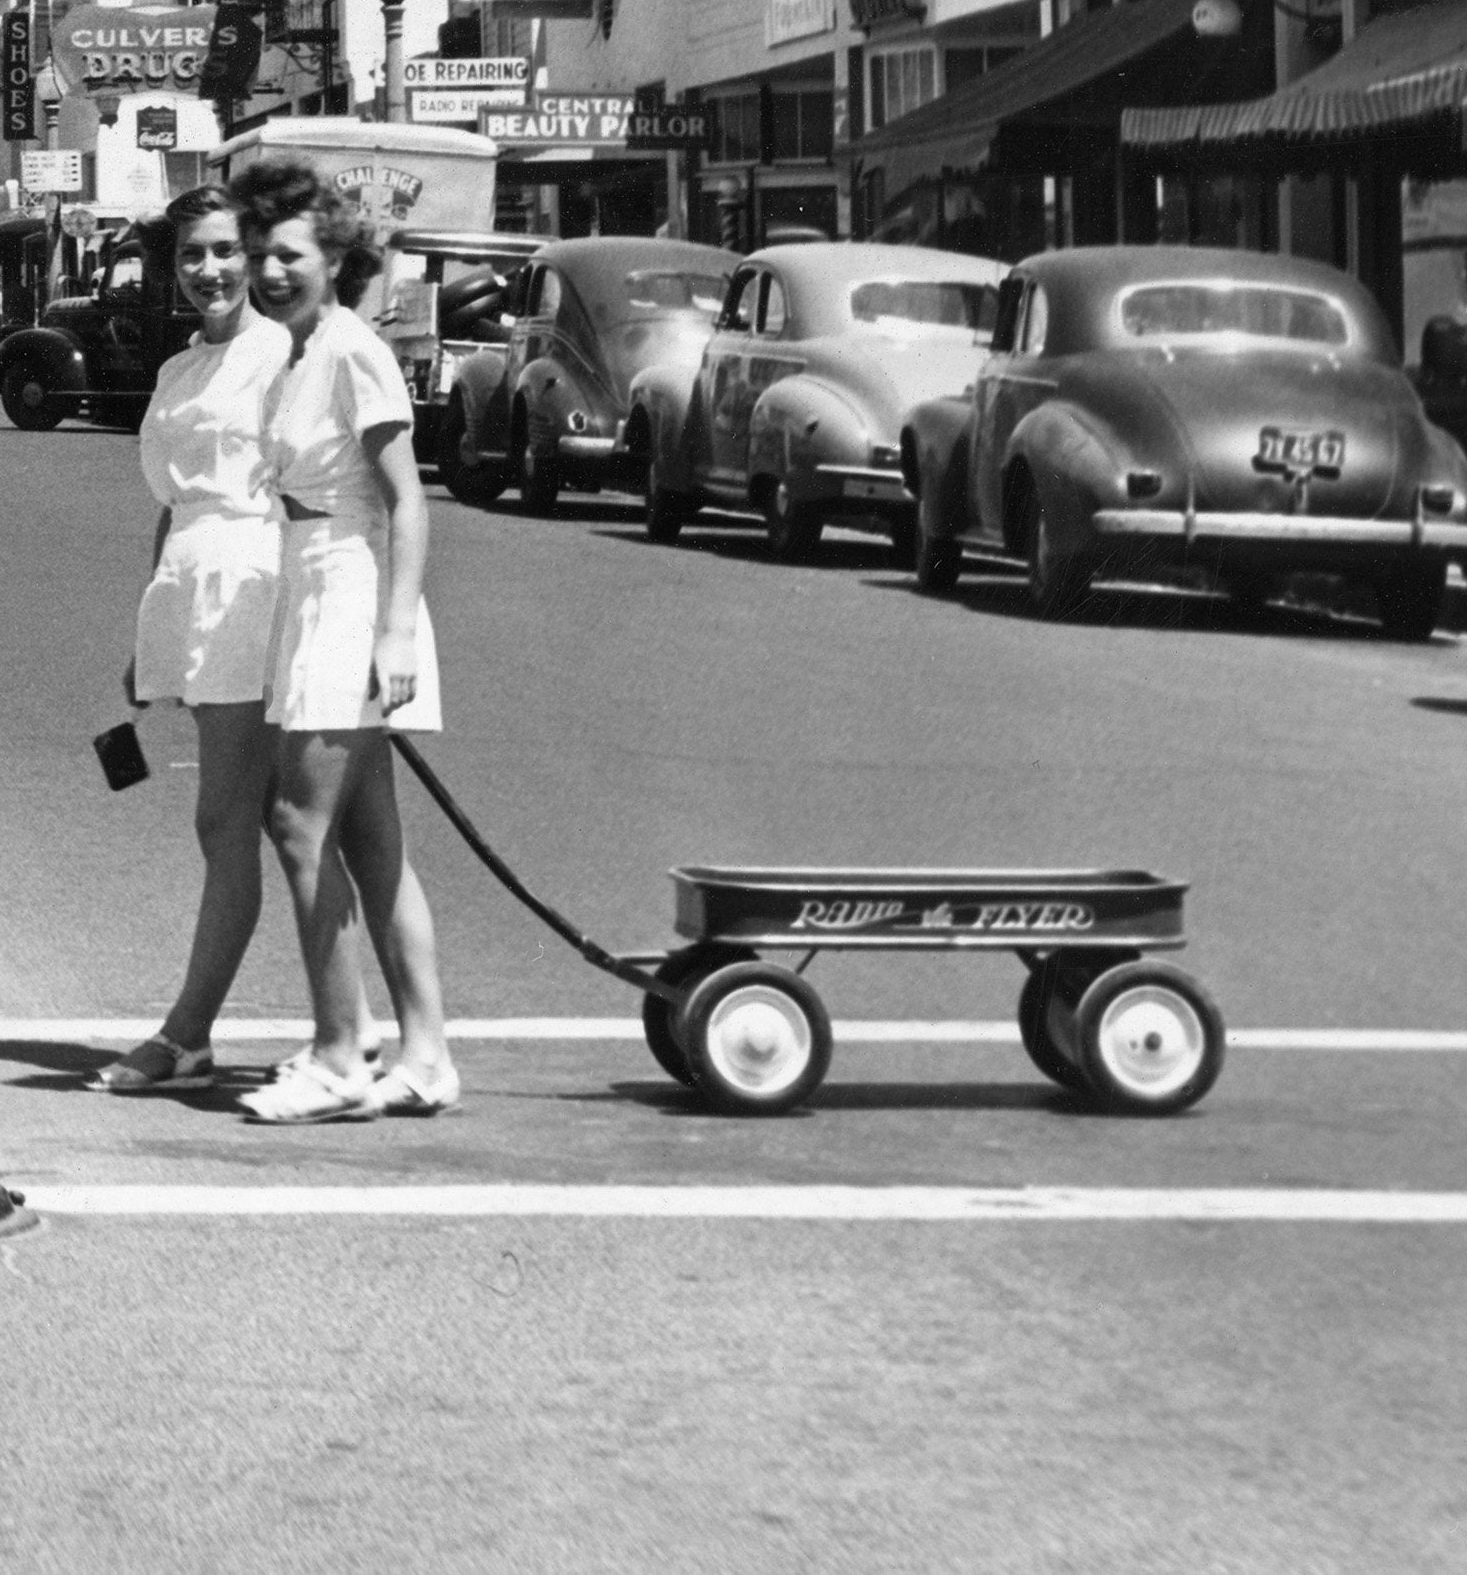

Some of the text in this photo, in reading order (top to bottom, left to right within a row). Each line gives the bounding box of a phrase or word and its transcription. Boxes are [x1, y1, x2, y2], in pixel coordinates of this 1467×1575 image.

[11, 22, 27, 131] SHOES
[435, 62, 527, 80] REPAIRING
[420, 100, 455, 112] RADIO
[542, 98, 646, 114] CENTRAL
[488, 114, 705, 137] BEAUTY PARLOR
[336, 167, 420, 195] CHALENGE
[971, 903, 1094, 929] FLYER
